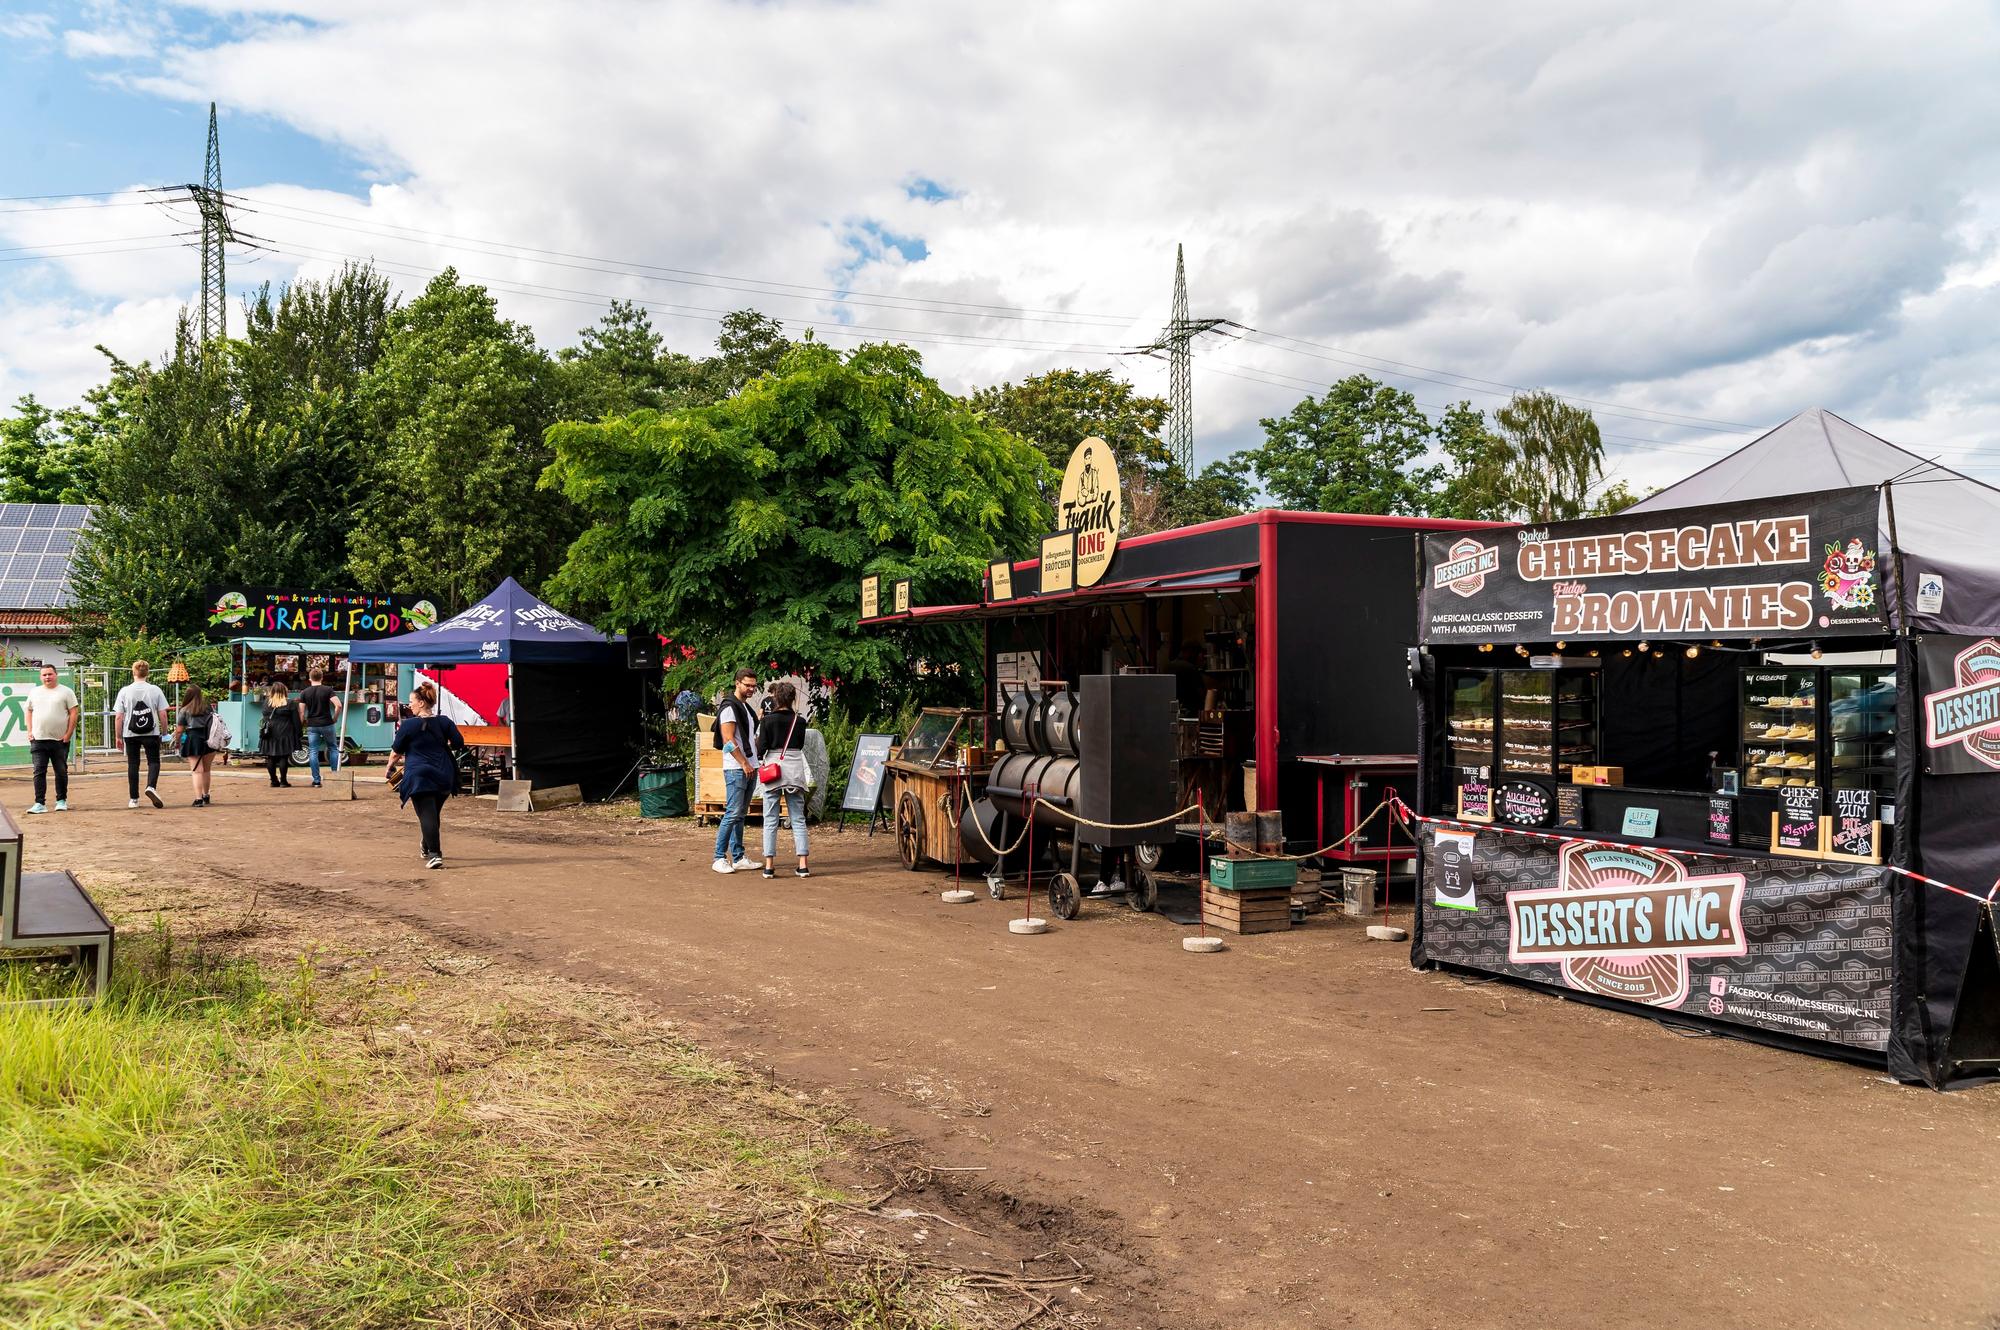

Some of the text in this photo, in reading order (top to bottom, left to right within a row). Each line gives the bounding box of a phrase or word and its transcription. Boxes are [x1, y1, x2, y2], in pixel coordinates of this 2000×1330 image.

[1063, 490, 1115, 534] Frank
[1078, 531, 1105, 556] ONG
[1518, 527, 1549, 549] Baked
[1517, 515, 1810, 581] CHEESECAKE
[1077, 553, 1105, 566] DOGSCHMIEDE
[1436, 552, 1496, 583] DESSERTS INC.
[1553, 580, 1586, 598] Fudge
[266, 594, 391, 608] vegan & vegetarian healthy food
[1551, 582, 1813, 635] BROWNIES
[259, 605, 339, 631] ISRAELI
[349, 608, 400, 635] FOOD
[1431, 611, 1543, 623] AMERICAN CLASSIC DESSERTS
[1830, 617, 1882, 625] DESSERTSINC.NL
[1431, 626, 1450, 634] WITH
[1459, 624, 1492, 633] MODERN
[1493, 624, 1517, 632] TWIST
[1936, 687, 2000, 735] DESSERT
[1462, 767, 1478, 775] THERE
[1471, 776, 1477, 784] IS
[1463, 793, 1479, 801] ROOM
[1506, 791, 1540, 804] AUCH ZUM
[1780, 786, 1819, 799] CHEESE
[1835, 790, 1870, 805] AUCH
[1505, 802, 1543, 815] MITNEHMEN
[1710, 800, 1730, 809] THERE
[1786, 797, 1812, 808] CAKE
[1632, 811, 1649, 820] LIFE
[1717, 808, 1723, 816] IS
[1839, 804, 1867, 818] ZUM
[1782, 821, 1816, 837] NY STYLE
[1832, 822, 1873, 847] NEHMEN
[1589, 856, 1604, 864] THE
[1624, 857, 1653, 871] STAND
[1518, 891, 1731, 947] DESSERTS INC.
[1743, 915, 1761, 925] SSERTS
[1597, 974, 1645, 991] SINCE 2015
[1833, 971, 1864, 980] DESSERTS
[1728, 985, 1880, 1020] FACEBOOK.COM/DESSERTSINC.NL
[1863, 1001, 1890, 1010] DESSER
[1727, 1005, 1831, 1032] WWW.DESSERTSINC.NL
